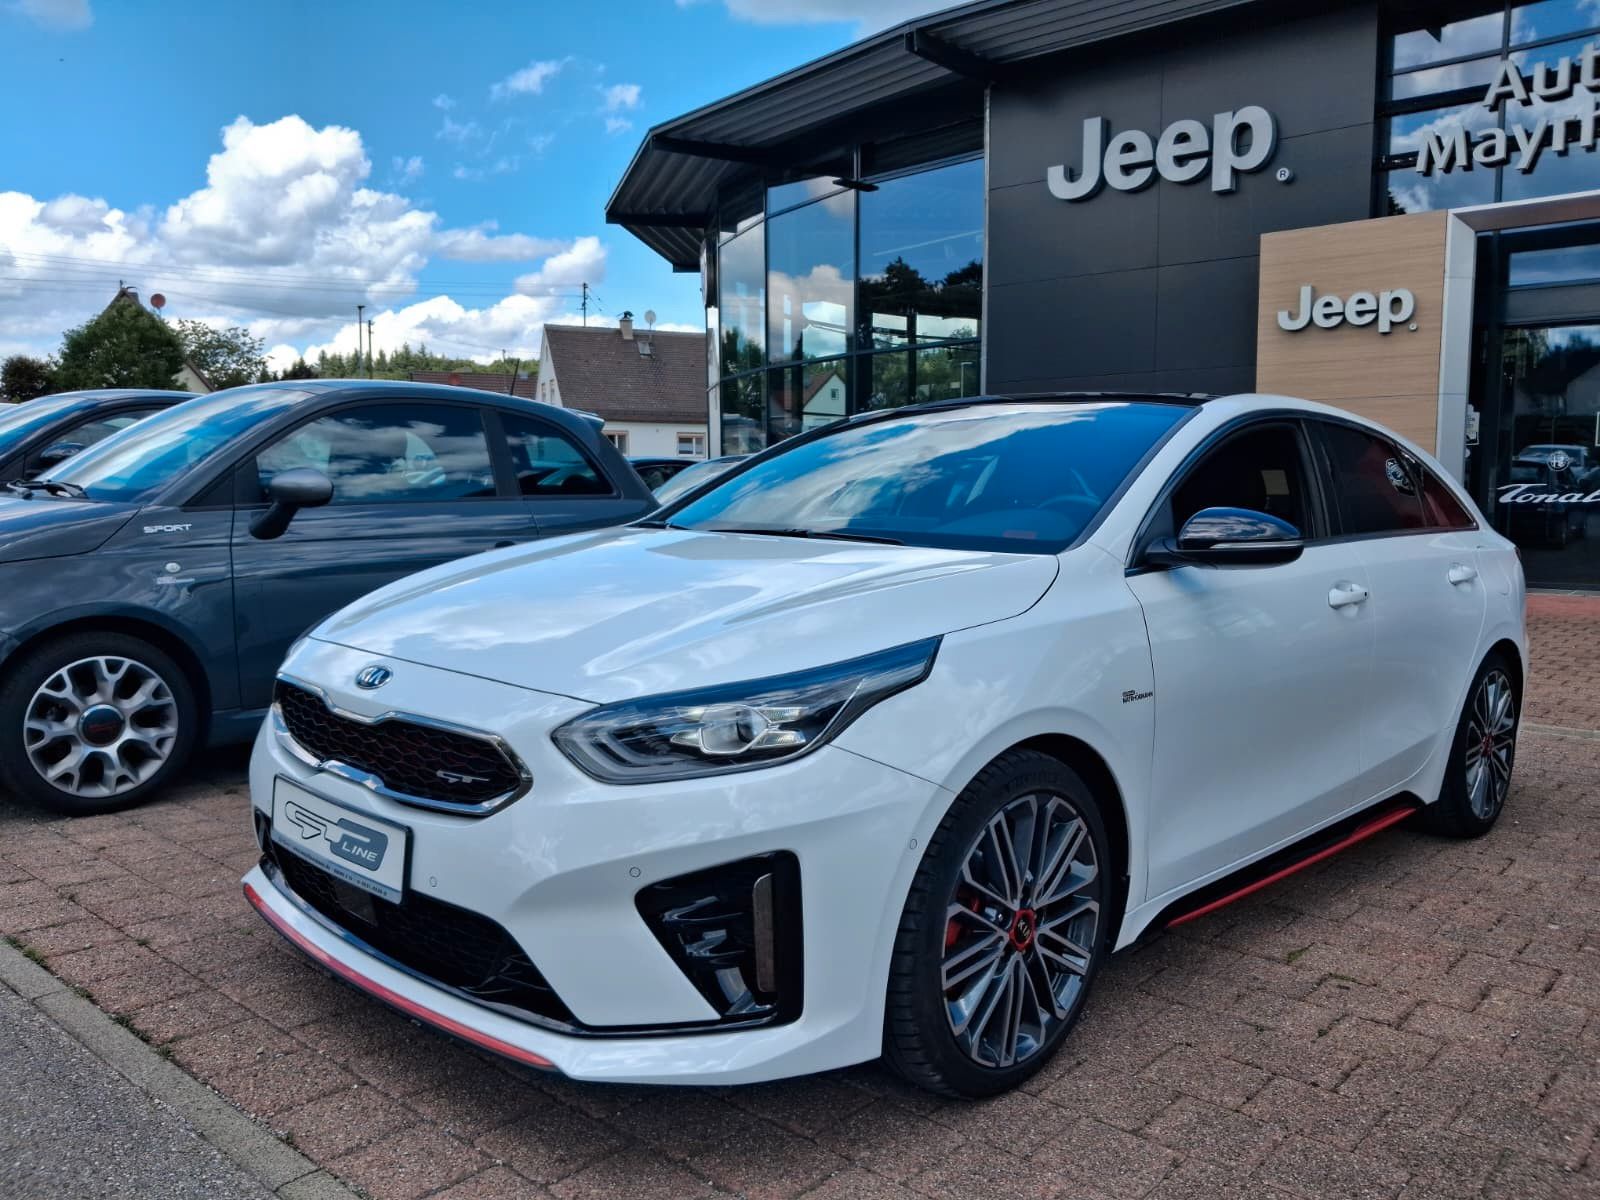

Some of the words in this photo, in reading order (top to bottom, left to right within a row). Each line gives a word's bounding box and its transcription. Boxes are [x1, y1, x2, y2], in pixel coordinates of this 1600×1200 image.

[1047, 105, 1277, 200] Jeep
[1277, 284, 1415, 332] Jeep
[143, 523, 192, 534] SPORT
[341, 840, 378, 862] LINE
